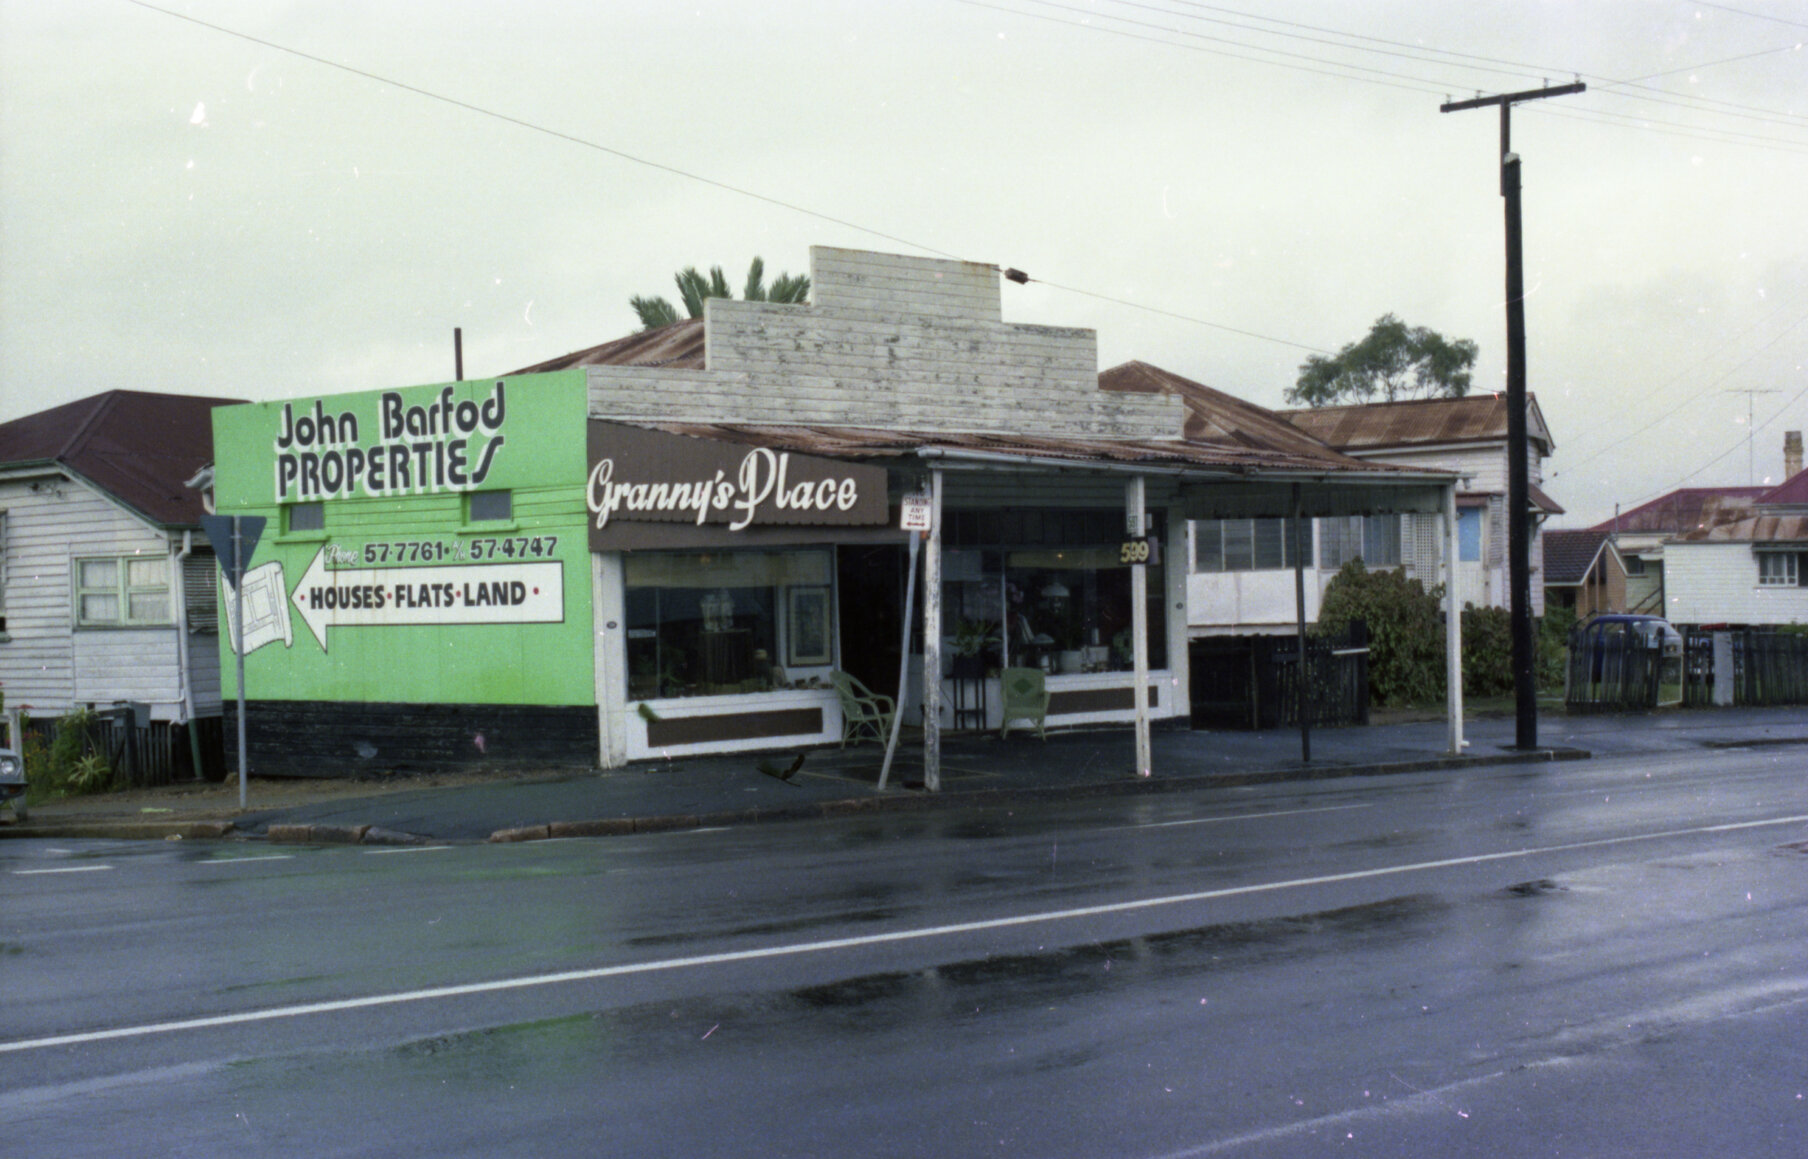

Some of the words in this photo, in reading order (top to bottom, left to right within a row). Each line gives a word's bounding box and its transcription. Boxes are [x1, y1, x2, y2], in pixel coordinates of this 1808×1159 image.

[276, 400, 358, 452] John
[380, 381, 505, 443] Barfod
[276, 435, 505, 502] PROPERTIES
[586, 458, 735, 529] Granny's
[729, 447, 858, 531] Place
[908, 513, 925, 521] TIME
[1120, 541, 1149, 563] 599
[310, 585, 386, 610] HOUSES
[395, 583, 455, 608] FLATS
[463, 581, 527, 607] LAND
